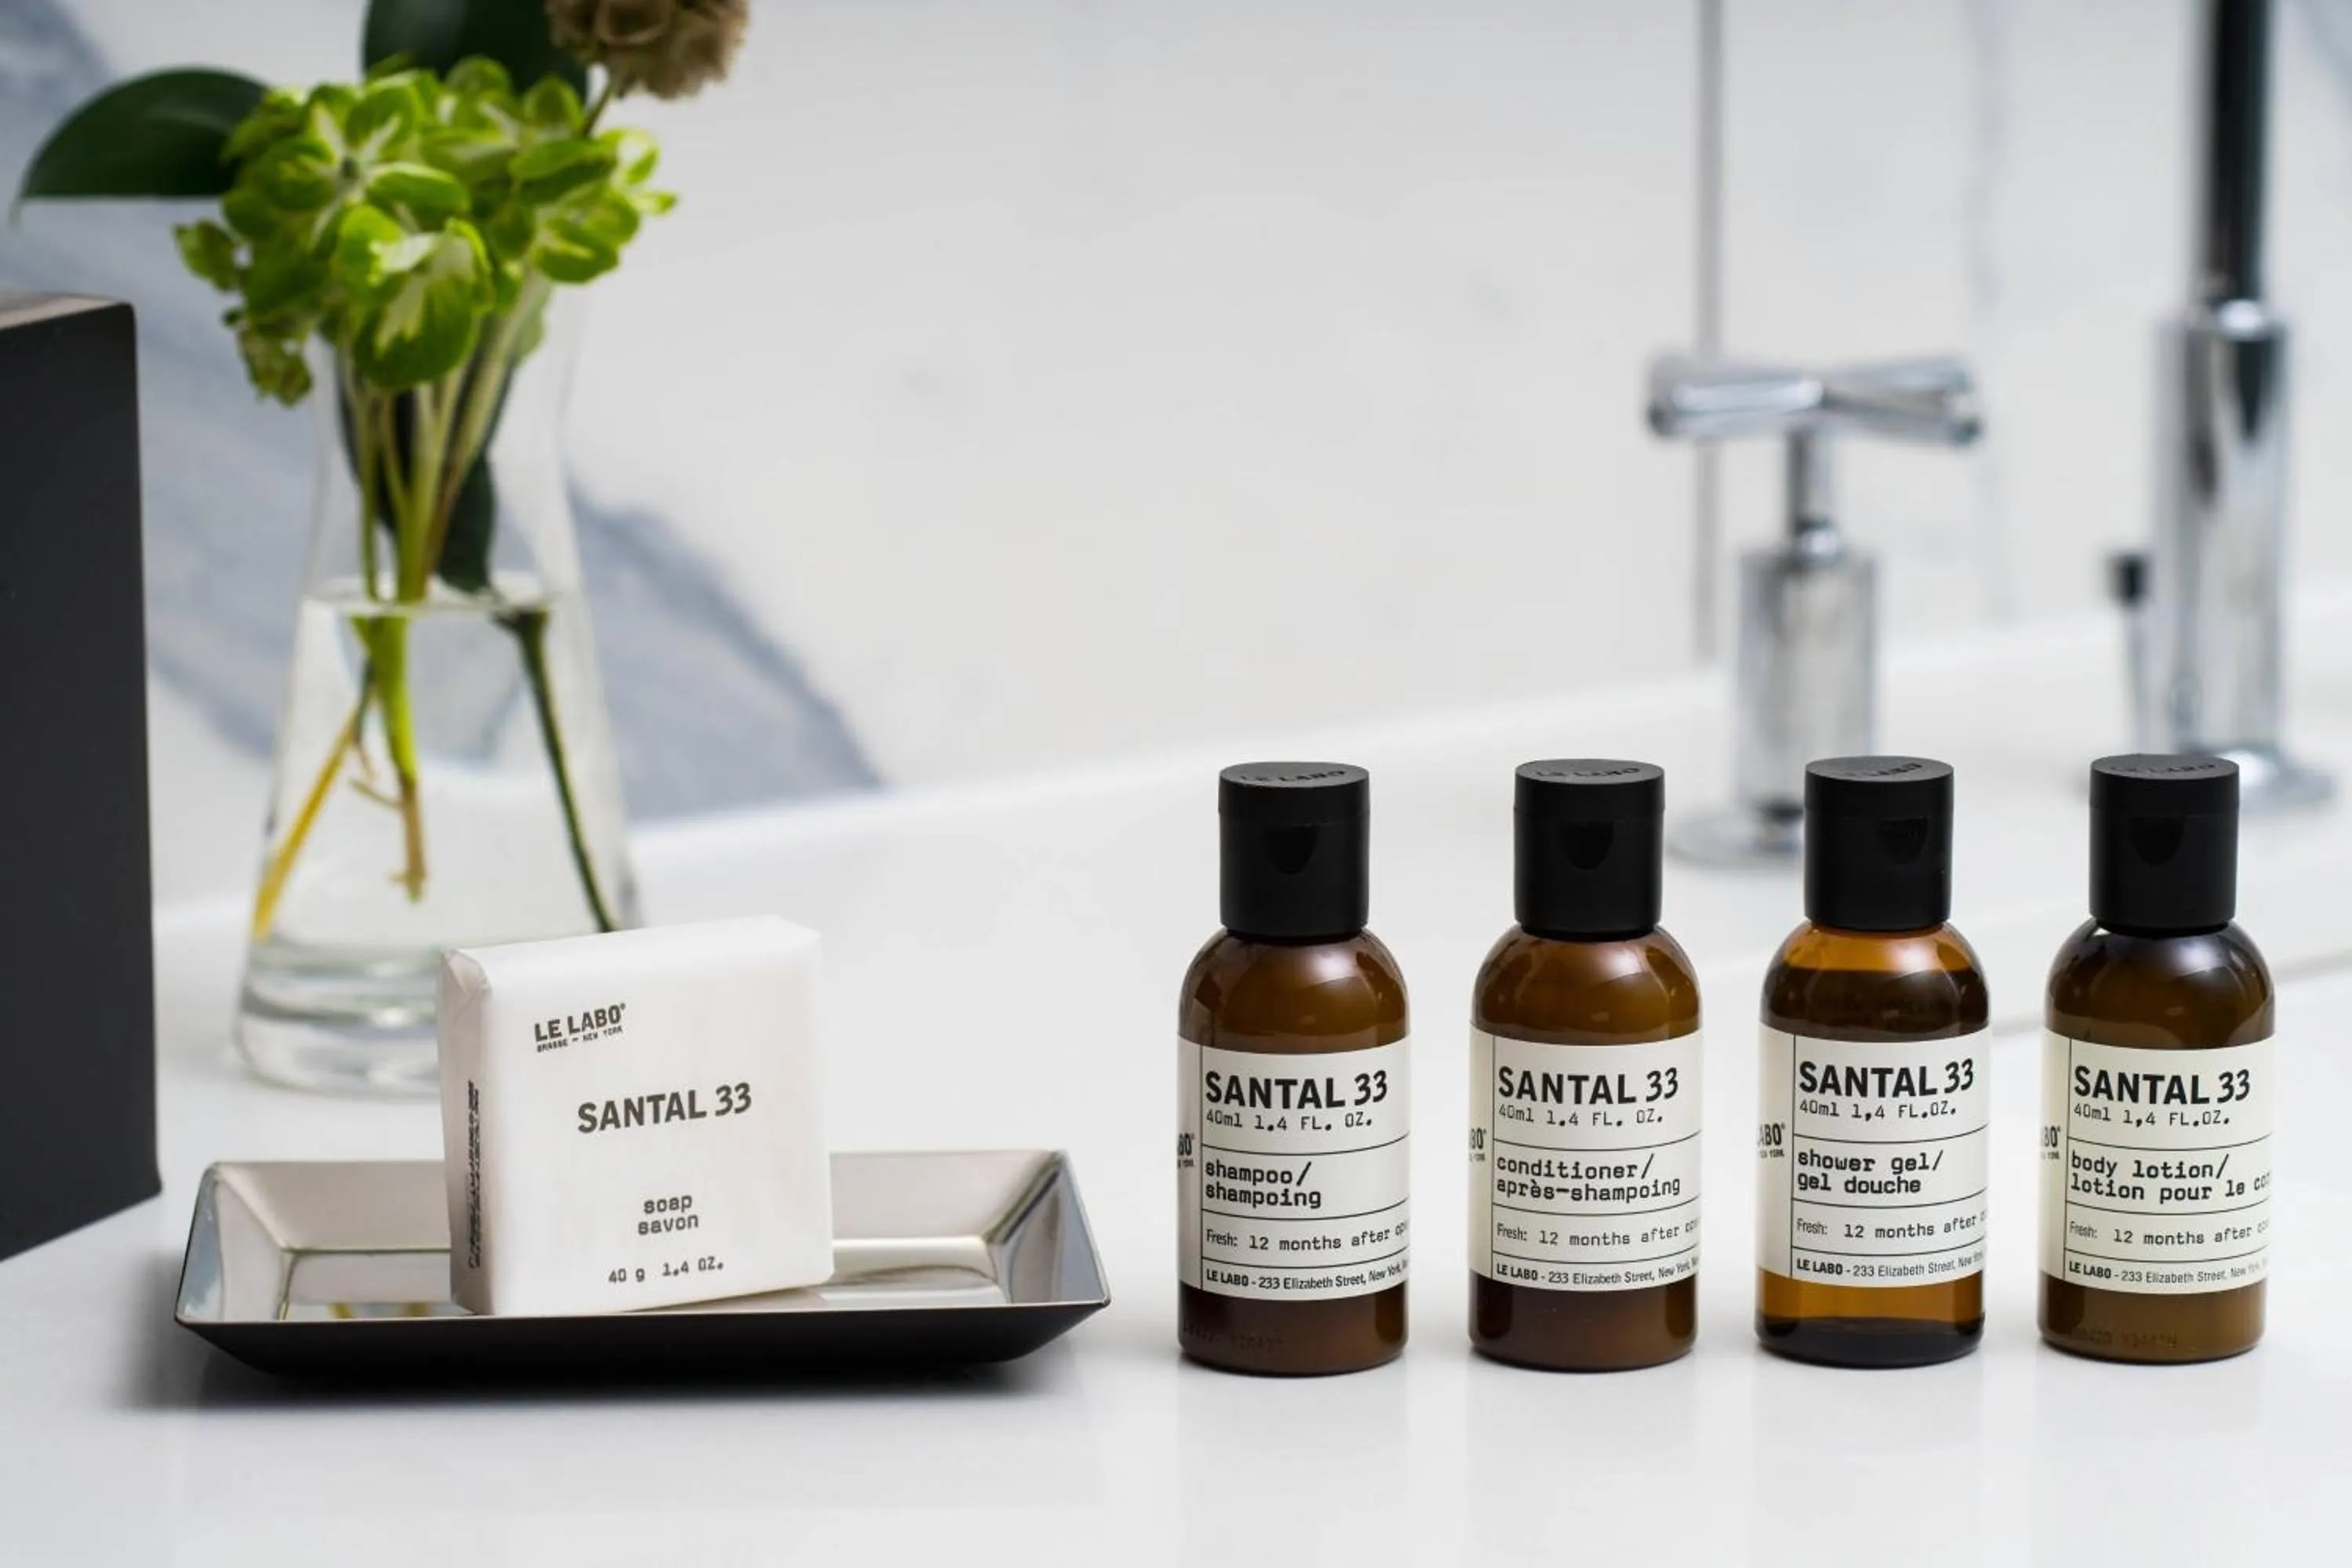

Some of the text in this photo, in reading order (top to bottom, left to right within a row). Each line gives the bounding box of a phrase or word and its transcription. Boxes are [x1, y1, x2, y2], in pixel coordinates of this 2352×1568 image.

[534, 1018, 562, 1042] LE
[1205, 1070, 1387, 1110] SANTAL 33
[1499, 1066, 1678, 1105] SANTAL 33
[1799, 1058, 1973, 1098] SANTAL 33
[2074, 1065, 2249, 1105] SANTAL 33
[578, 1083, 751, 1134] SANTAL 33
[1207, 1109, 1371, 1131] 40ml 1.4 FL. OZ.
[1499, 1104, 1662, 1127] 40ml 1.4 FL. OZ.
[1800, 1100, 1839, 1116] 40ml
[2074, 1104, 2111, 1121] 40ml
[1205, 1159, 1311, 1186] shampoo/
[1497, 1154, 1653, 1180] conditioner/
[1798, 1149, 1943, 1174] shower gel/
[2072, 1151, 2117, 1178] body
[2132, 1154, 2229, 1179] lotion/
[1496, 1178, 1679, 1203] après-shampoing
[1798, 1173, 1921, 1193] gel douche
[2071, 1173, 2144, 1200] lotion
[2160, 1187, 2212, 1204] pour
[2226, 1180, 2245, 1197] le
[644, 1196, 694, 1216] soap
[1204, 1181, 1320, 1210] shampoing
[638, 1212, 699, 1236] savon
[1497, 1222, 1527, 1241] Fresh:
[1540, 1230, 1558, 1245] 12
[1570, 1232, 1629, 1246] months
[1641, 1227, 1679, 1242] after
[1797, 1216, 1976, 1238] Fresh: 12 months after
[2070, 1221, 2097, 1238] Fresh:
[2114, 1229, 2132, 1243] 12
[2143, 1232, 2204, 1245] months
[2214, 1227, 2252, 1242] after
[1207, 1229, 1237, 1247] Fresh:
[1250, 1236, 1269, 1250] 12
[1279, 1236, 1341, 1250] months
[1352, 1229, 1389, 1247] after
[608, 1269, 626, 1283] 40
[636, 1269, 644, 1283] g
[662, 1261, 688, 1276] 1.4
[1206, 1268, 1218, 1283] LE
[1220, 1269, 1249, 1287] LABO
[1258, 1277, 1280, 1290] 233
[1283, 1277, 1334, 1290] Elizabeth
[1335, 1272, 1366, 1287] Street,
[1368, 1267, 1386, 1281] New
[1496, 1262, 1508, 1276] LE
[1510, 1265, 1538, 1280] LABO
[1548, 1272, 1569, 1283] 233
[1573, 1272, 1622, 1284] Elizabeth
[1624, 1269, 1655, 1283] Street,
[1657, 1265, 1676, 1279] New
[1796, 1258, 1811, 1271] LE
[1813, 1261, 1843, 1275] LABO
[1853, 1265, 1875, 1277] 233
[1878, 1265, 1926, 1277] Elizabeth
[2069, 1261, 2081, 1273] LE
[2083, 1262, 2111, 1279] LABO
[2121, 1272, 2143, 1282] 233
[2146, 1272, 2194, 1283] Elizabeth
